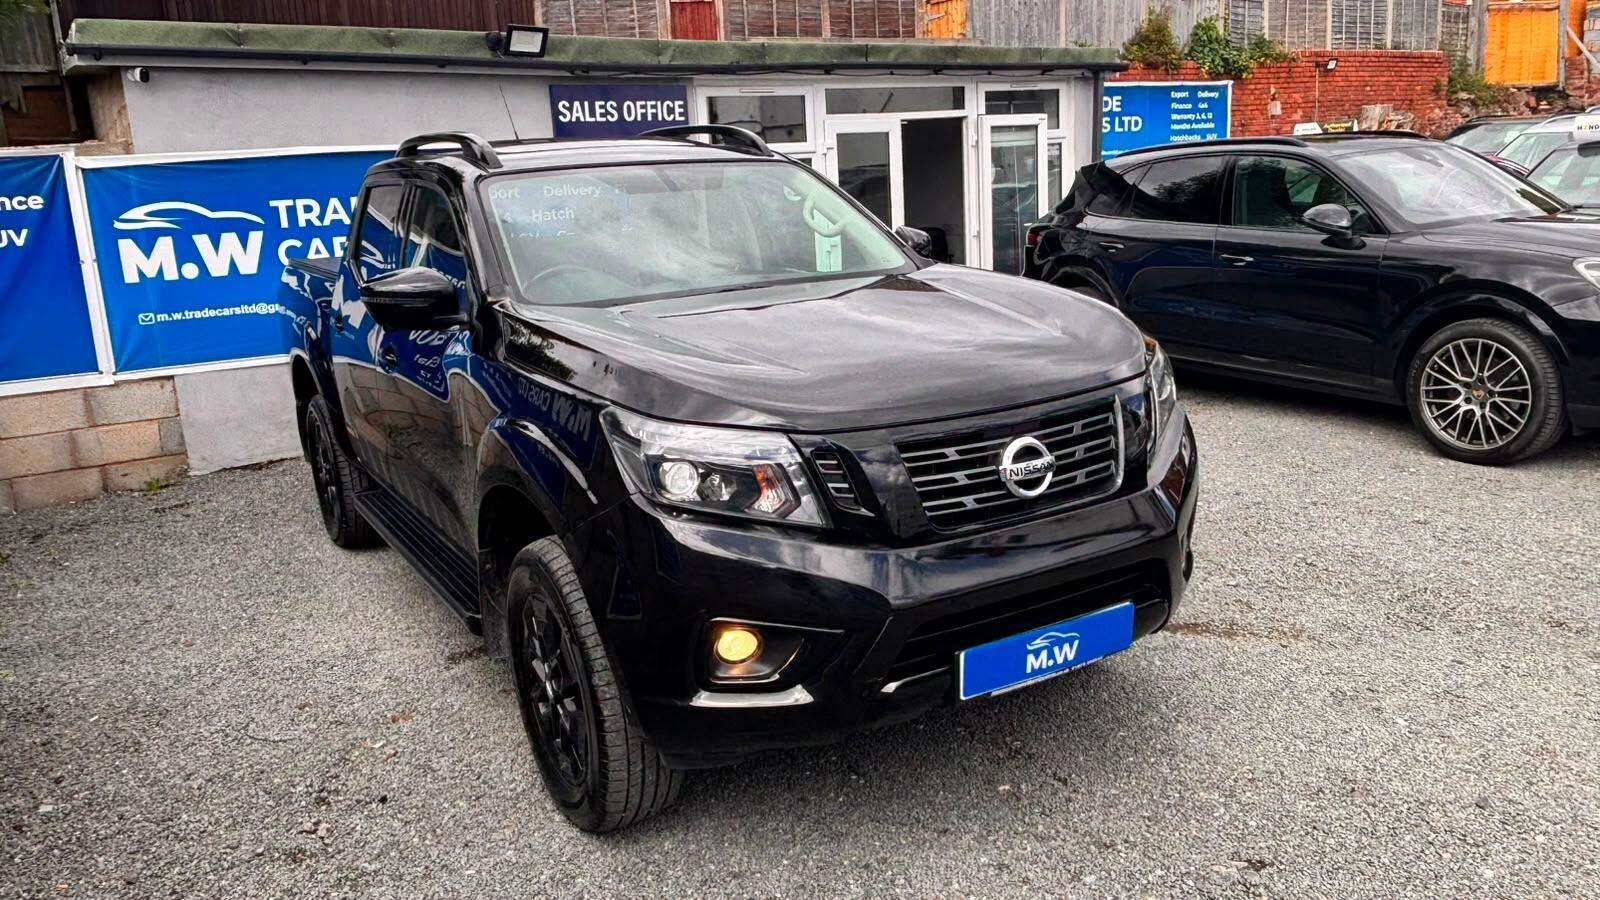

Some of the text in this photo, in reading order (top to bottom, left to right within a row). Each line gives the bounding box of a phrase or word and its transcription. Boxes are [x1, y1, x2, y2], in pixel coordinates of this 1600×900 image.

[1102, 95, 1122, 112] DE
[1171, 91, 1219, 99] Export Delivery
[557, 100, 685, 122] SALES OFFICE
[1114, 115, 1143, 133] LTD
[1191, 121, 1215, 129] Available
[543, 183, 602, 198] Delivery
[0, 195, 44, 211] nce
[531, 207, 575, 222] Hatch
[117, 230, 263, 285] M.W
[1008, 460, 1054, 478] NISSAN
[1025, 639, 1080, 674] M.W
